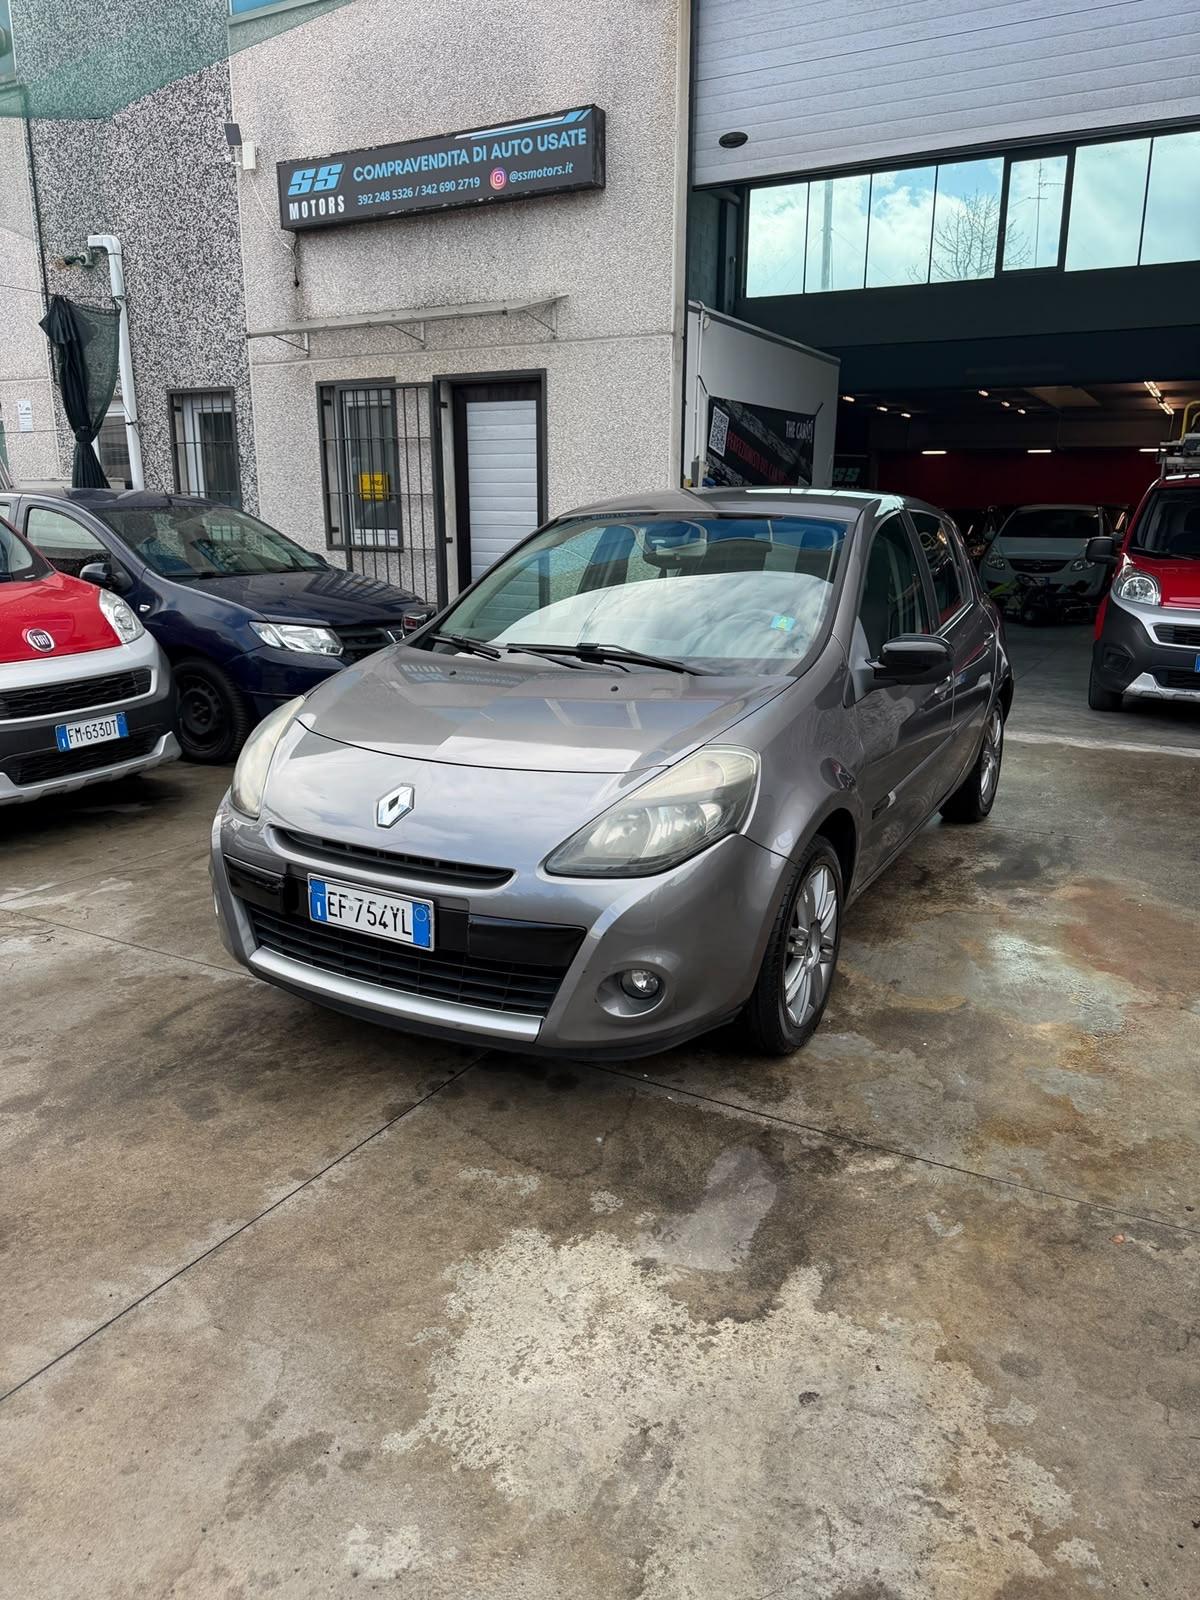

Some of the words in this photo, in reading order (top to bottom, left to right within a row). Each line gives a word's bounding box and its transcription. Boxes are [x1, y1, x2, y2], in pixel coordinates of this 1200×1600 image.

[353, 149, 469, 181] COMPRAVENDITA
[473, 145, 487, 163] DI
[490, 138, 534, 160] AUTO
[537, 128, 587, 151] USATE
[287, 163, 343, 196] SS
[509, 162, 574, 182] @ssmotors.it
[358, 193, 373, 205] 392
[375, 190, 391, 203] 248
[392, 187, 413, 200] 5326
[414, 185, 419, 196] /
[421, 183, 438, 196] 342
[439, 180, 456, 193] 690
[457, 176, 480, 190] 2719
[289, 195, 345, 220] MOTORS
